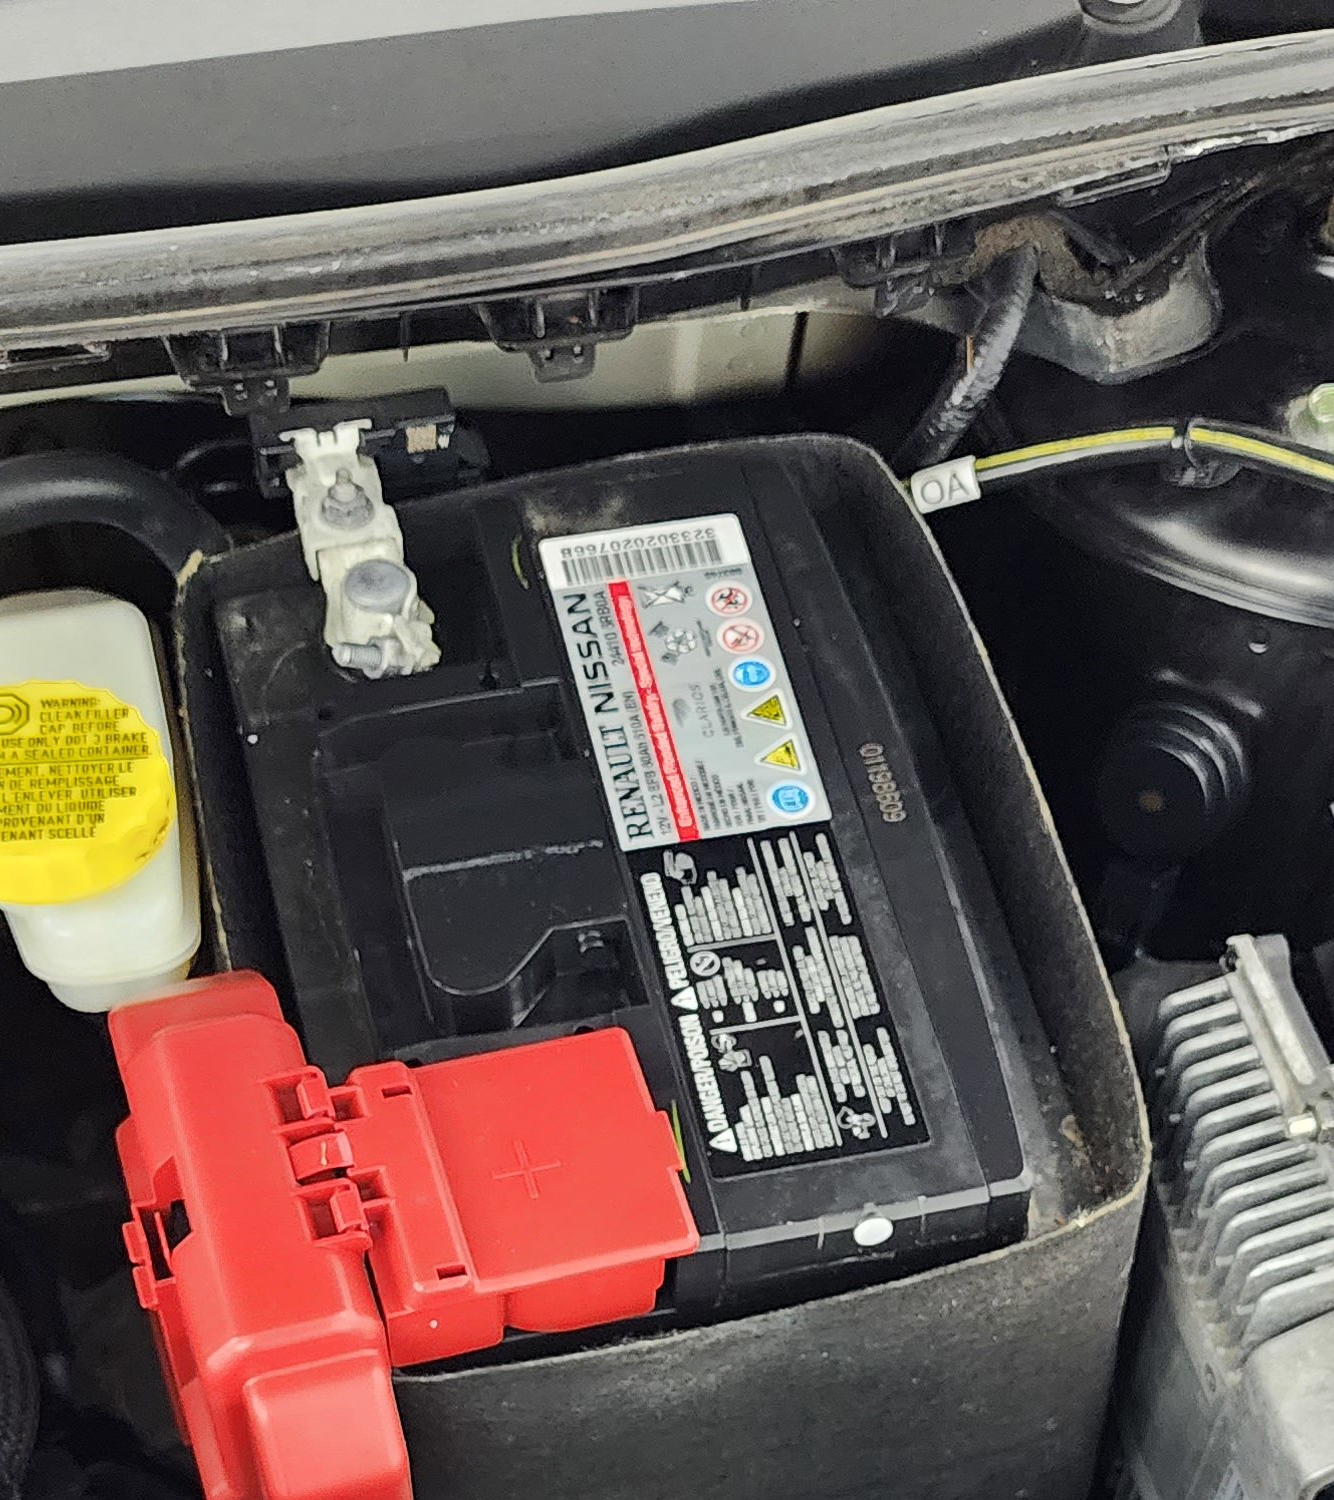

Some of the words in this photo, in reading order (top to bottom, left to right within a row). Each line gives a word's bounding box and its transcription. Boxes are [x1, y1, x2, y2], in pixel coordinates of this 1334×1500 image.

[563, 592, 619, 716] NISSAN
[40, 710, 81, 723] CLEAN
[87, 708, 129, 720] FILLER
[40, 724, 65, 736] CAP
[73, 721, 120, 734] BEFORE
[2, 737, 24, 749] USE
[28, 736, 60, 748] ONLY
[66, 734, 87, 746] DOT
[105, 732, 147, 744] BRAKE
[11, 750, 19, 760] A
[24, 748, 74, 760] SEALED
[49, 763, 114, 775] NETTOYER
[119, 761, 134, 773] LE
[9, 779, 21, 791] DE
[29, 775, 120, 790] REMPLISSAGE
[599, 723, 653, 841] RENAULT
[80, 786, 137, 800] UTILISER
[36, 802, 53, 814] DU
[57, 800, 106, 812] LIQUIDE
[678, 1013, 729, 1133] DANGER/POISON
